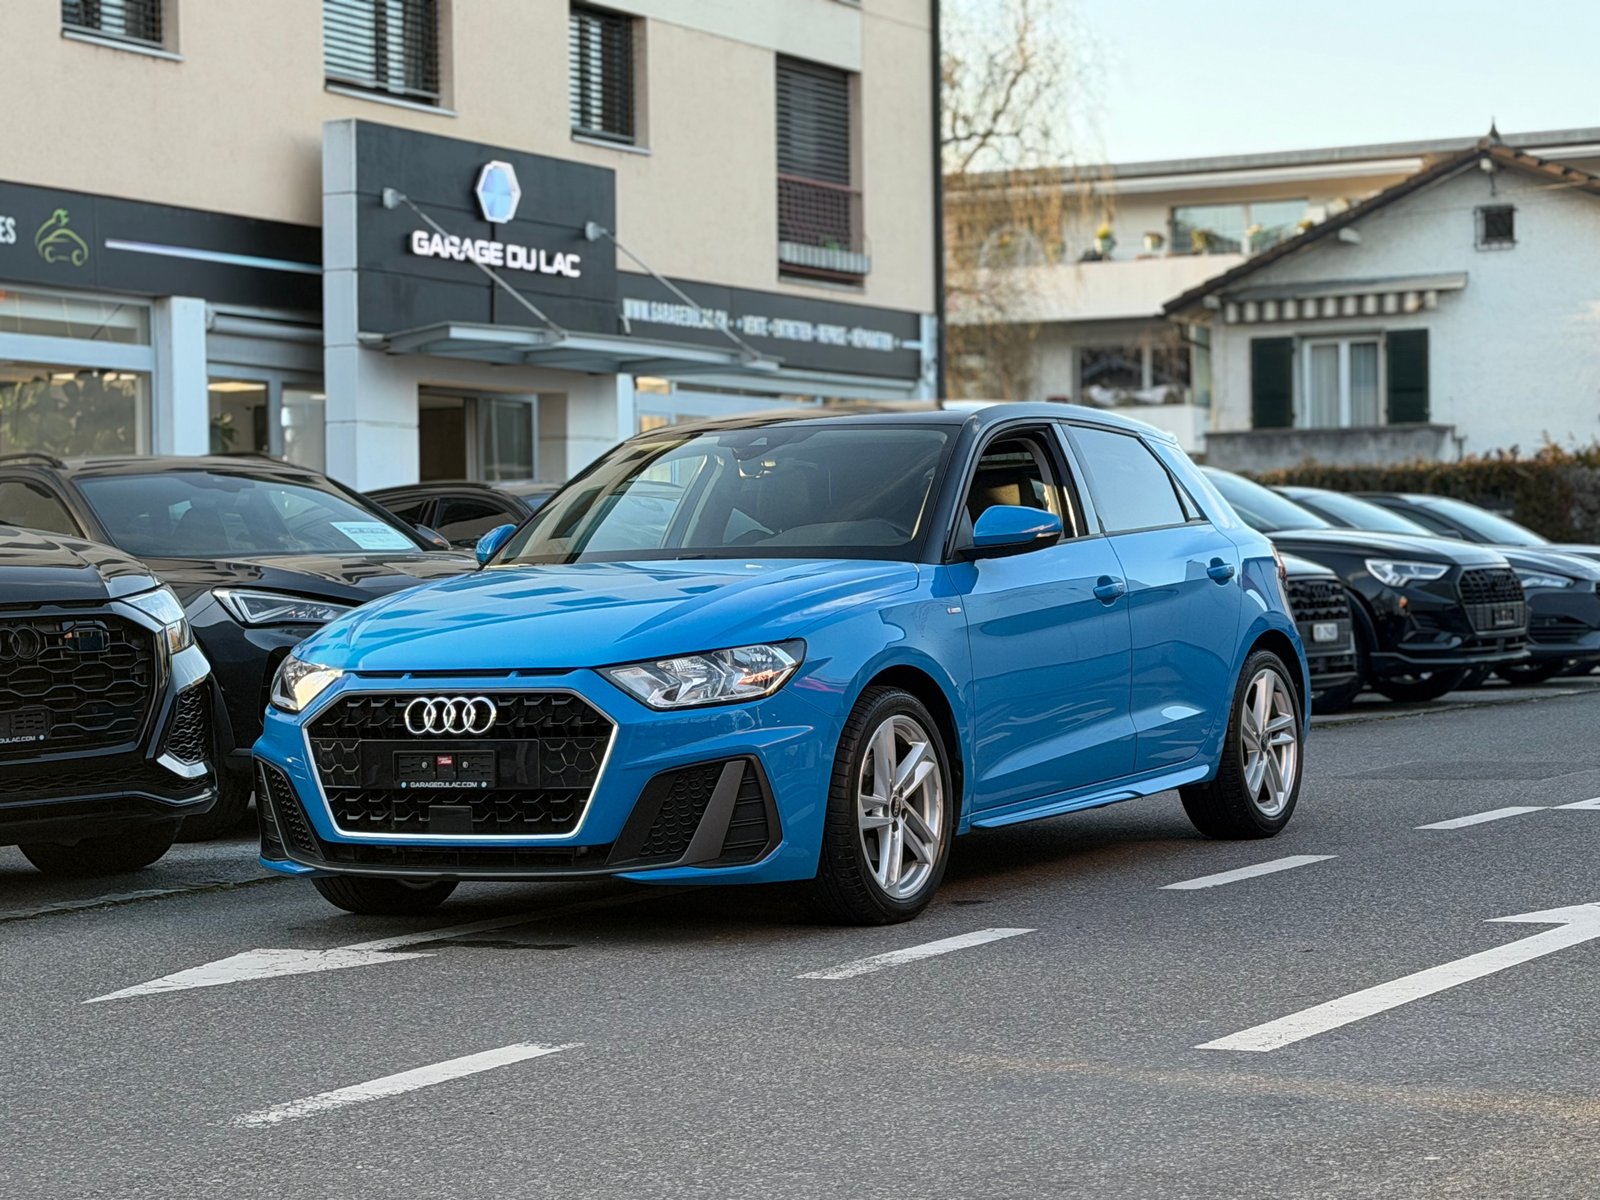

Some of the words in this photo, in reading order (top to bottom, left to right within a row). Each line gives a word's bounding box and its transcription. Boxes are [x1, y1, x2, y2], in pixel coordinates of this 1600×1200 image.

[412, 229, 504, 267] GARAGE
[506, 243, 537, 272] DU
[539, 249, 582, 278] LAC
[409, 781, 478, 789] GARAGEDULAC.COM
